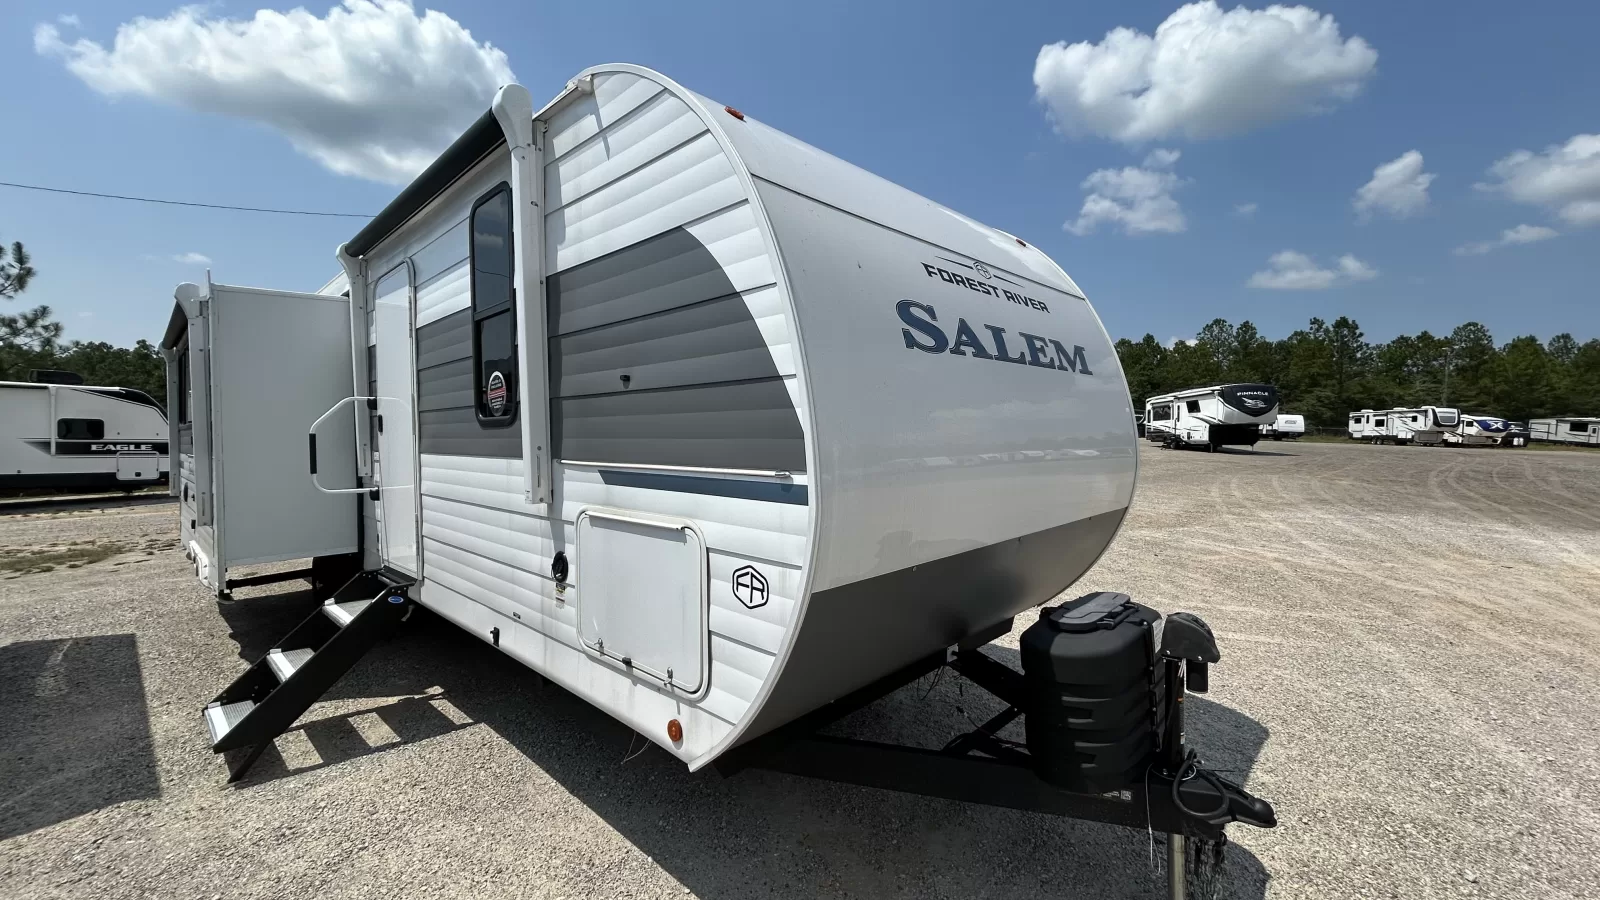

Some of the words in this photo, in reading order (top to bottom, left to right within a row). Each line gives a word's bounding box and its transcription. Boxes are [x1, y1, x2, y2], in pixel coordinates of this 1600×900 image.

[921, 262, 1000, 298] FOREST
[1001, 288, 1051, 314] RIVER
[895, 299, 1094, 376] SALEM
